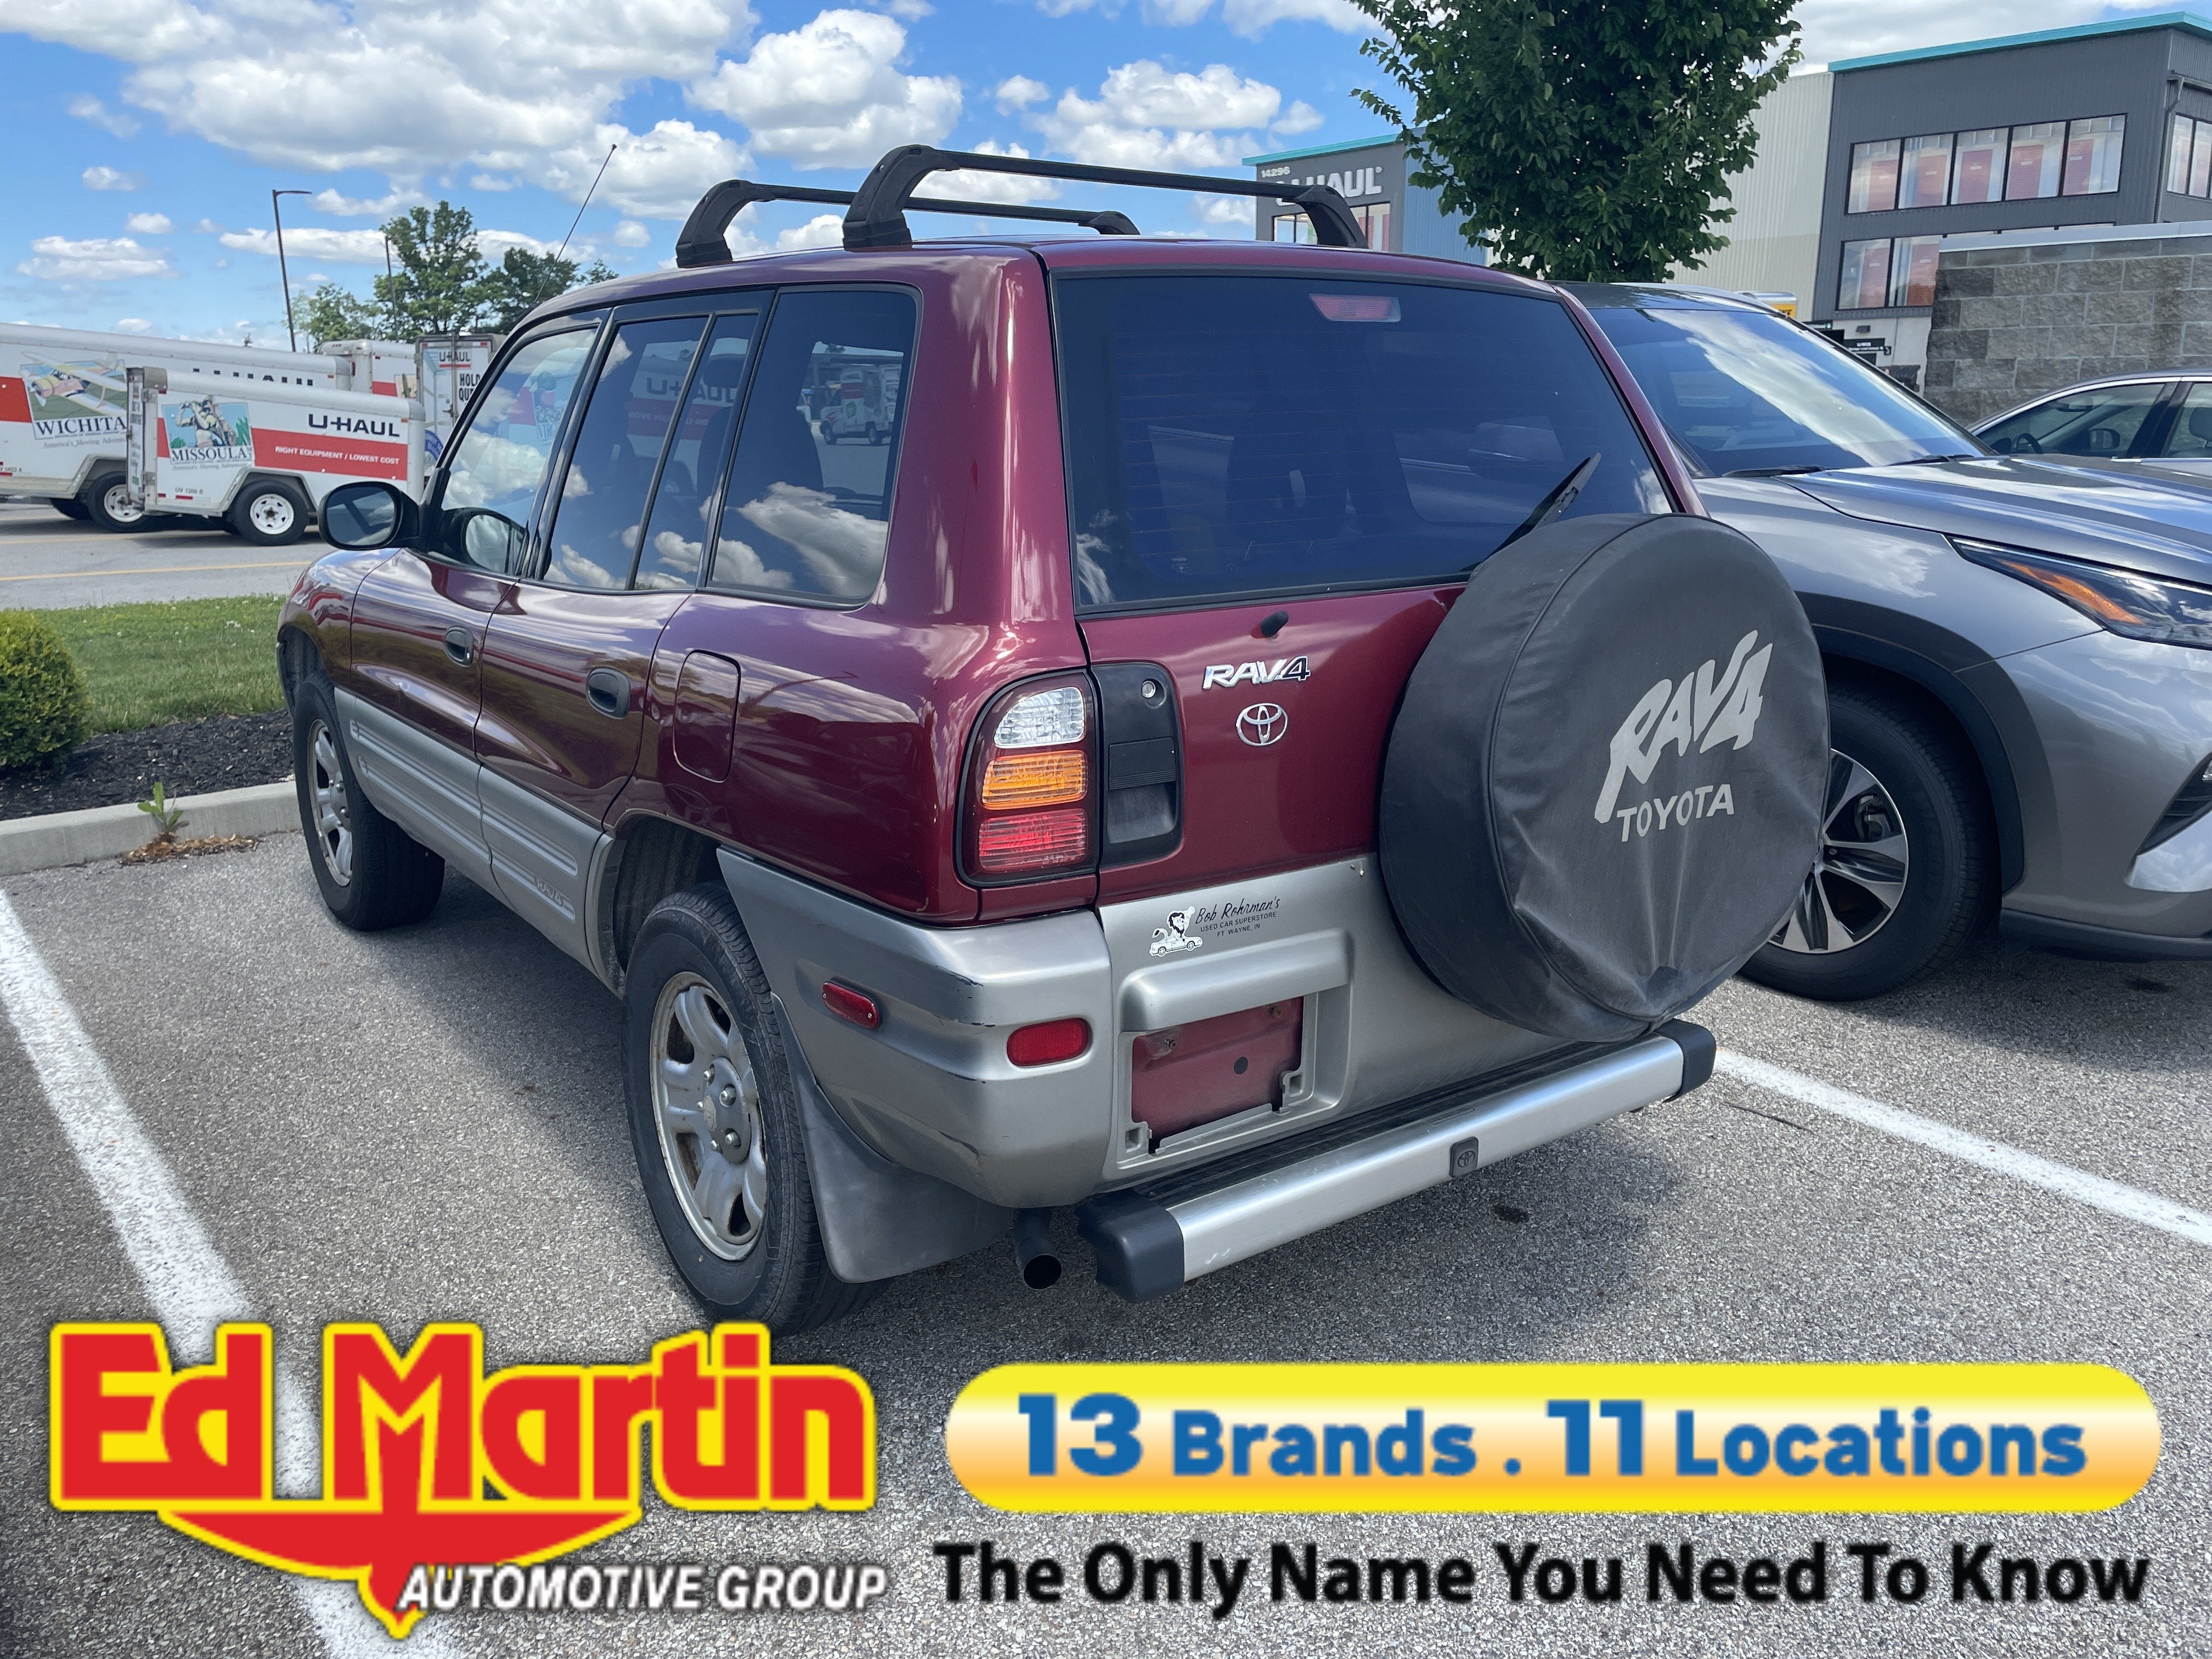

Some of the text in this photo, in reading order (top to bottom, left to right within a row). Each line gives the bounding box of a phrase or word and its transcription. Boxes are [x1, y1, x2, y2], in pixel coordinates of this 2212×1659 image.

[36, 416, 126, 436] WICHITA
[308, 414, 400, 437] U-HAUL
[172, 447, 247, 462] MISSOULA
[275, 445, 298, 455] RIGHT
[300, 448, 343, 460] EQUIPMENT
[349, 454, 379, 462] LOWEST
[380, 456, 400, 465] COST
[1203, 655, 1311, 690] RAV4
[1594, 630, 1773, 824] RAV4
[1616, 783, 1734, 842] TOYOTA
[1195, 896, 1281, 925] Bob Rohrman's
[1220, 920, 1234, 928] CAR
[1234, 911, 1277, 926] SUPERSTORE
